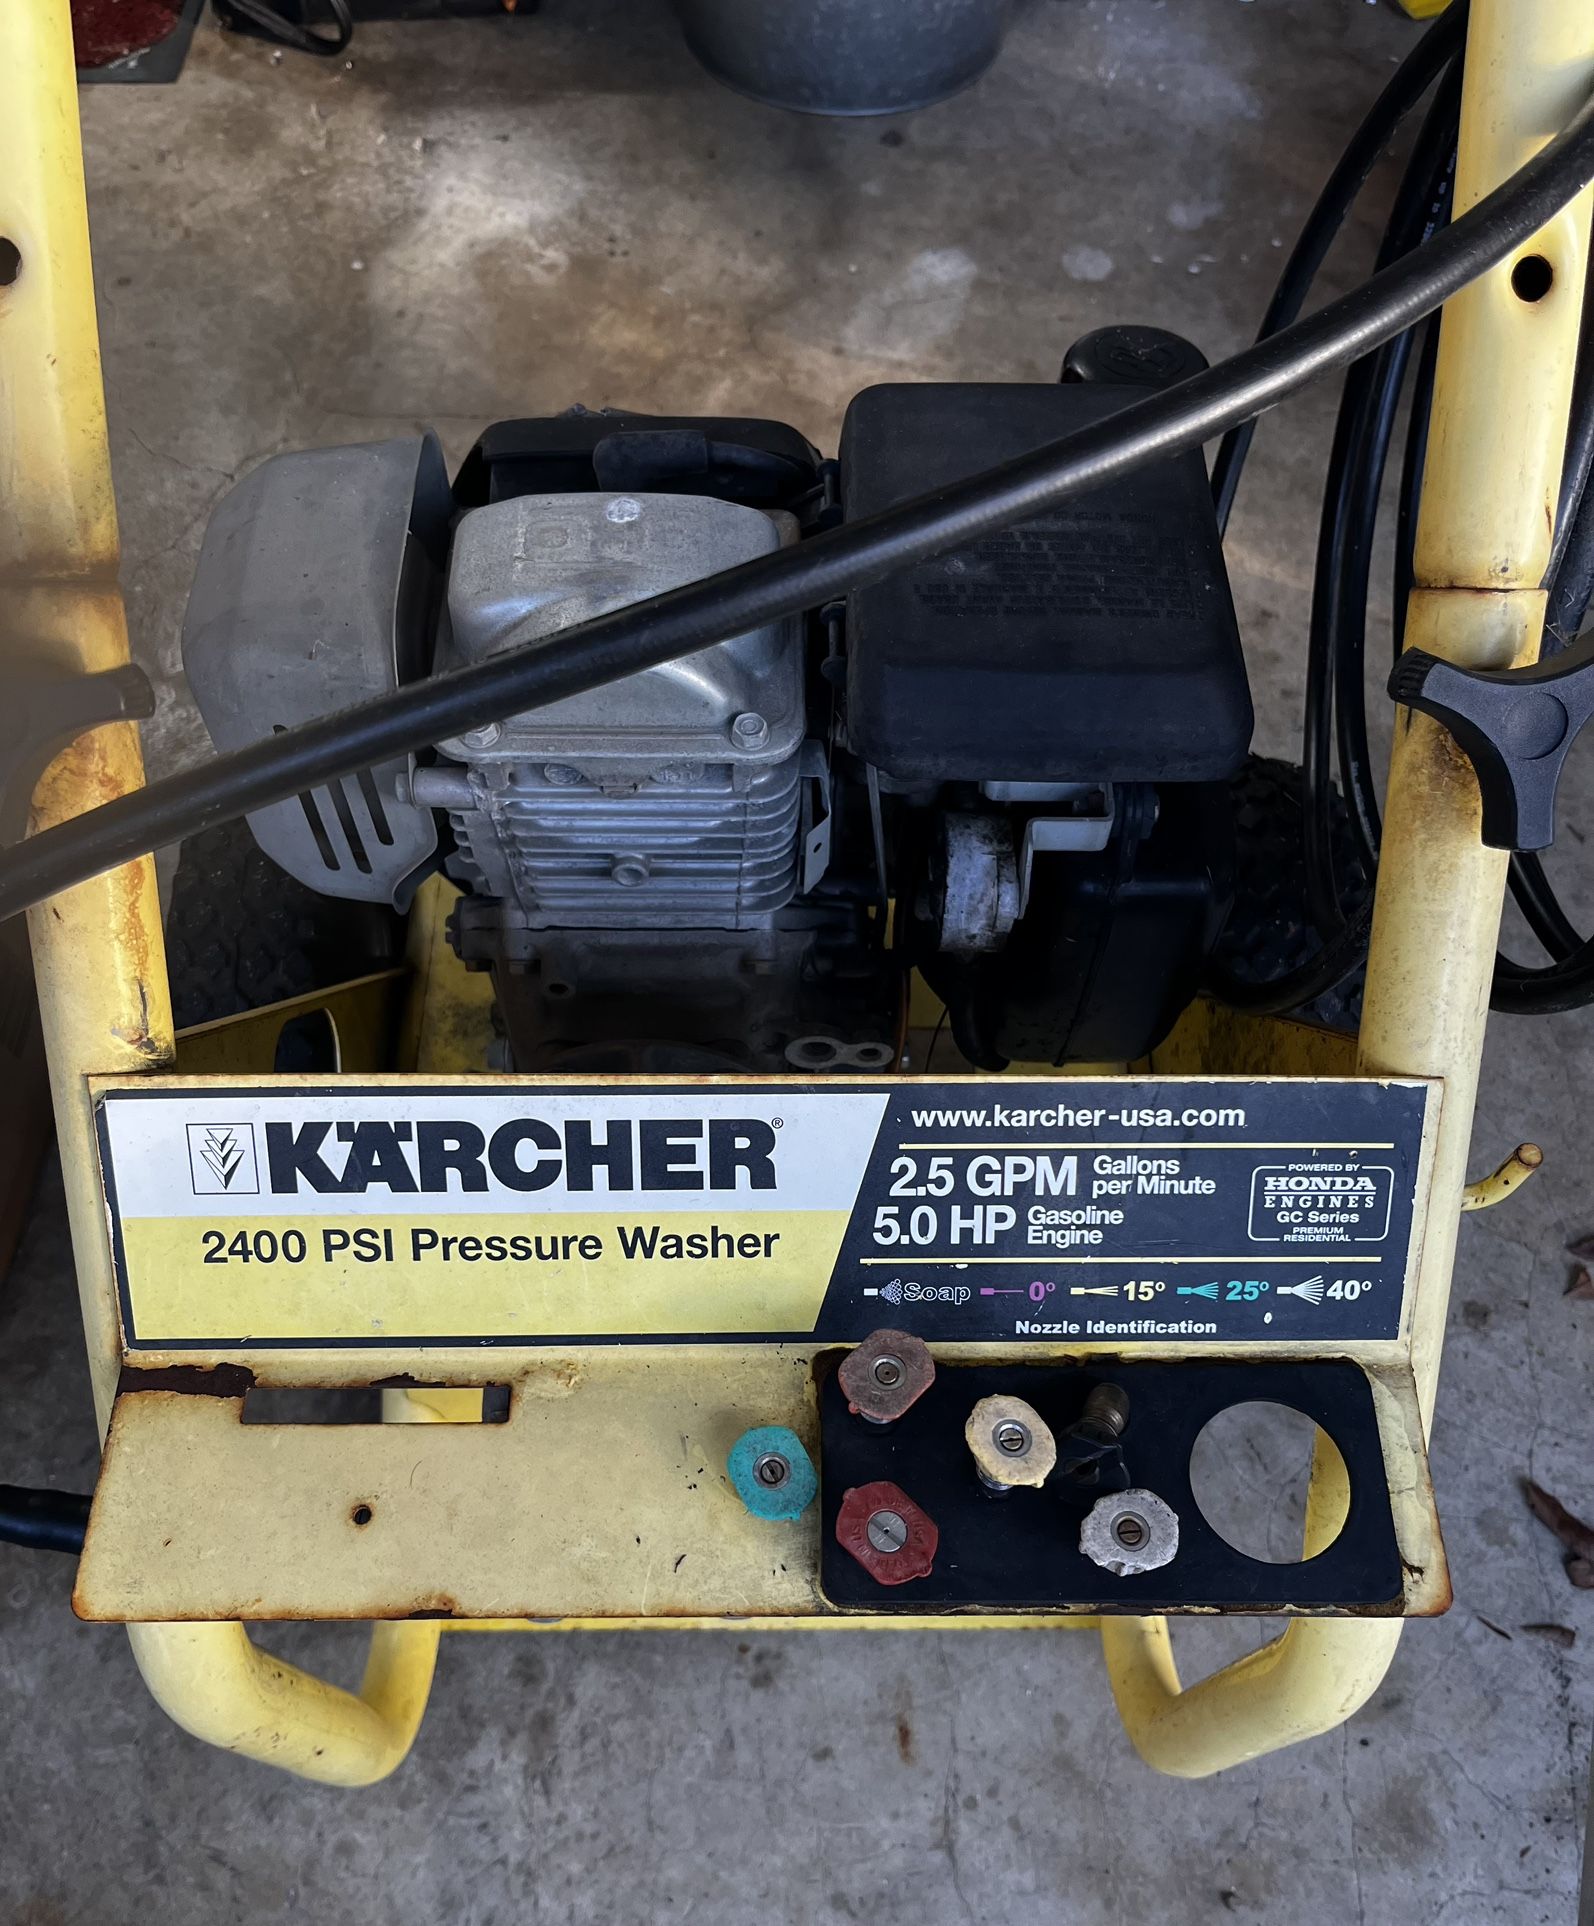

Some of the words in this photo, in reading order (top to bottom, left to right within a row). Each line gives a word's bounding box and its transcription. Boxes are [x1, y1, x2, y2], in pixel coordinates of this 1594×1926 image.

[911, 1103, 1246, 1128] www.karcher-usa.com
[1093, 1154, 1180, 1175] Gallons
[889, 1156, 955, 1197] 2.5
[966, 1155, 1078, 1197] GPM
[1264, 1176, 1377, 1191] HONDA
[1092, 1179, 1134, 1199] per
[1136, 1175, 1217, 1195] Minute
[1264, 1195, 1375, 1208] ENGINES
[872, 1205, 938, 1246] 5.0
[950, 1204, 1017, 1245] HP
[1027, 1205, 1125, 1225] Gasoline
[1276, 1210, 1303, 1223] GC
[1307, 1210, 1360, 1223] Series
[1027, 1225, 1104, 1249] Engine
[1283, 1234, 1352, 1242] RESIDENTIAL
[1292, 1226, 1344, 1234] PREMIUM
[201, 1229, 307, 1264] 2400
[322, 1227, 394, 1263] PSI
[410, 1228, 603, 1262] Pressure
[616, 1225, 781, 1260] Washer
[904, 1282, 971, 1305] Soap
[1015, 1320, 1081, 1334] Nozzle
[1086, 1319, 1218, 1334] Identification
